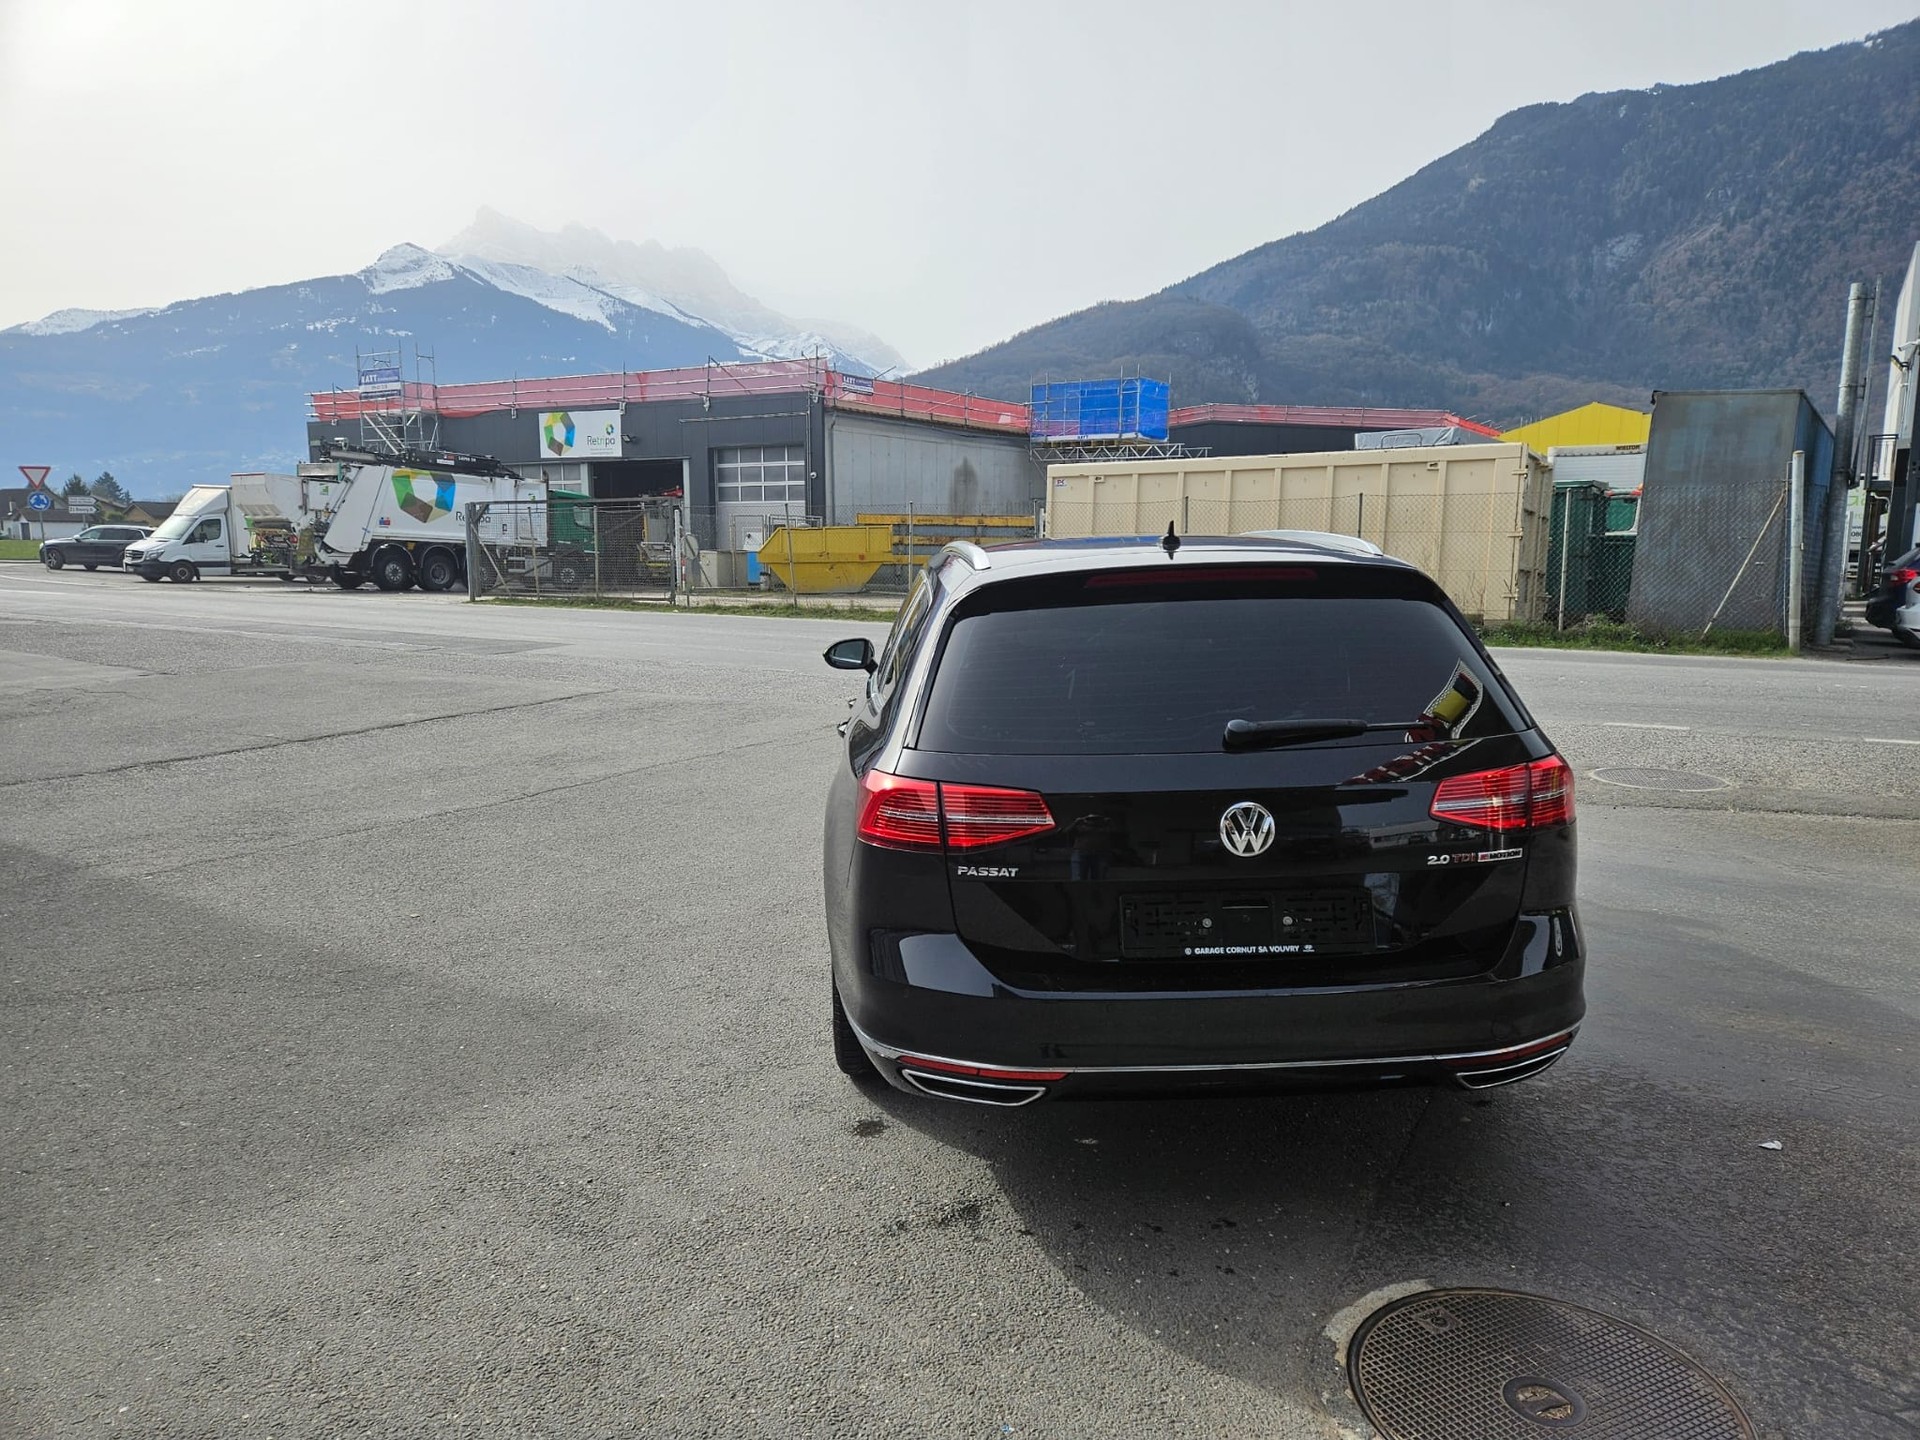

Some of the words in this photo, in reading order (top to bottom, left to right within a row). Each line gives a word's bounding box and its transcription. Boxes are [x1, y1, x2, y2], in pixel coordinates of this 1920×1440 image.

[1452, 853, 1476, 864] TDI
[957, 866, 1019, 877] PASSAT
[1194, 947, 1225, 955] GARAGE
[1226, 946, 1257, 954] CORNUT
[1269, 945, 1300, 953] VOUVRY
